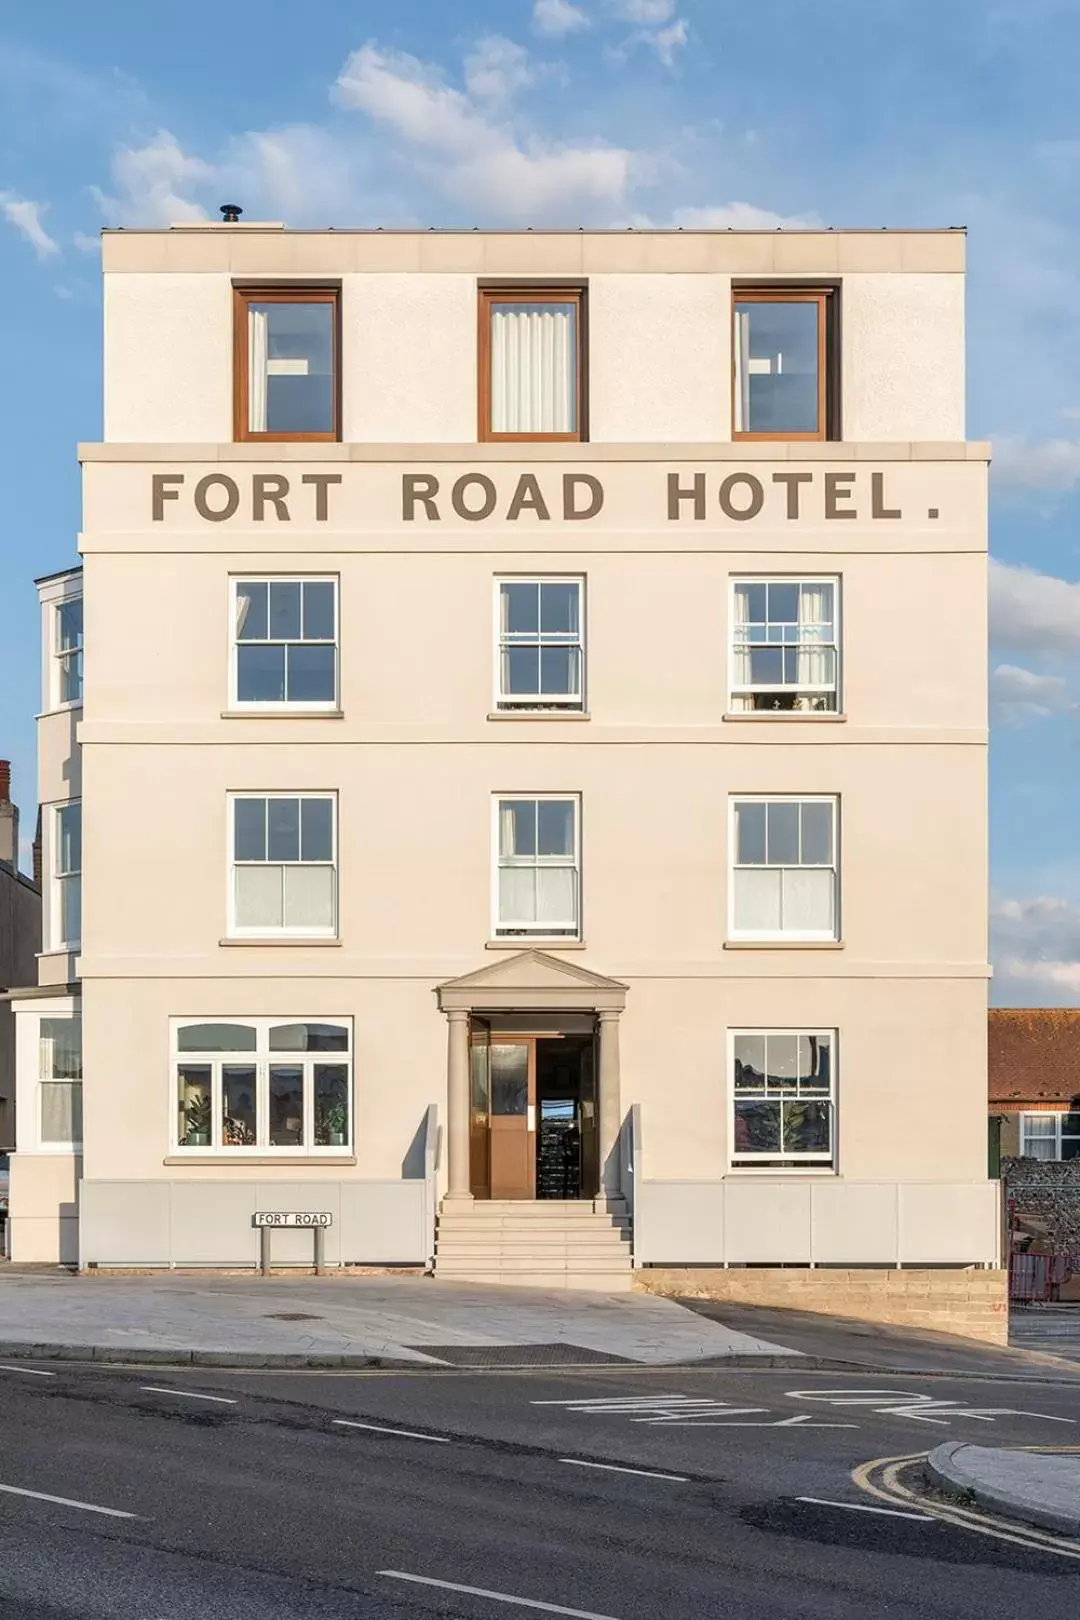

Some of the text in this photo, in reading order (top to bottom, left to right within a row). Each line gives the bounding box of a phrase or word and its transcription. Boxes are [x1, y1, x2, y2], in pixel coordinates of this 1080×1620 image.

[152, 473, 341, 521] FORT
[402, 472, 603, 520] ROAD
[259, 1214, 328, 1225] FORT ROAD
